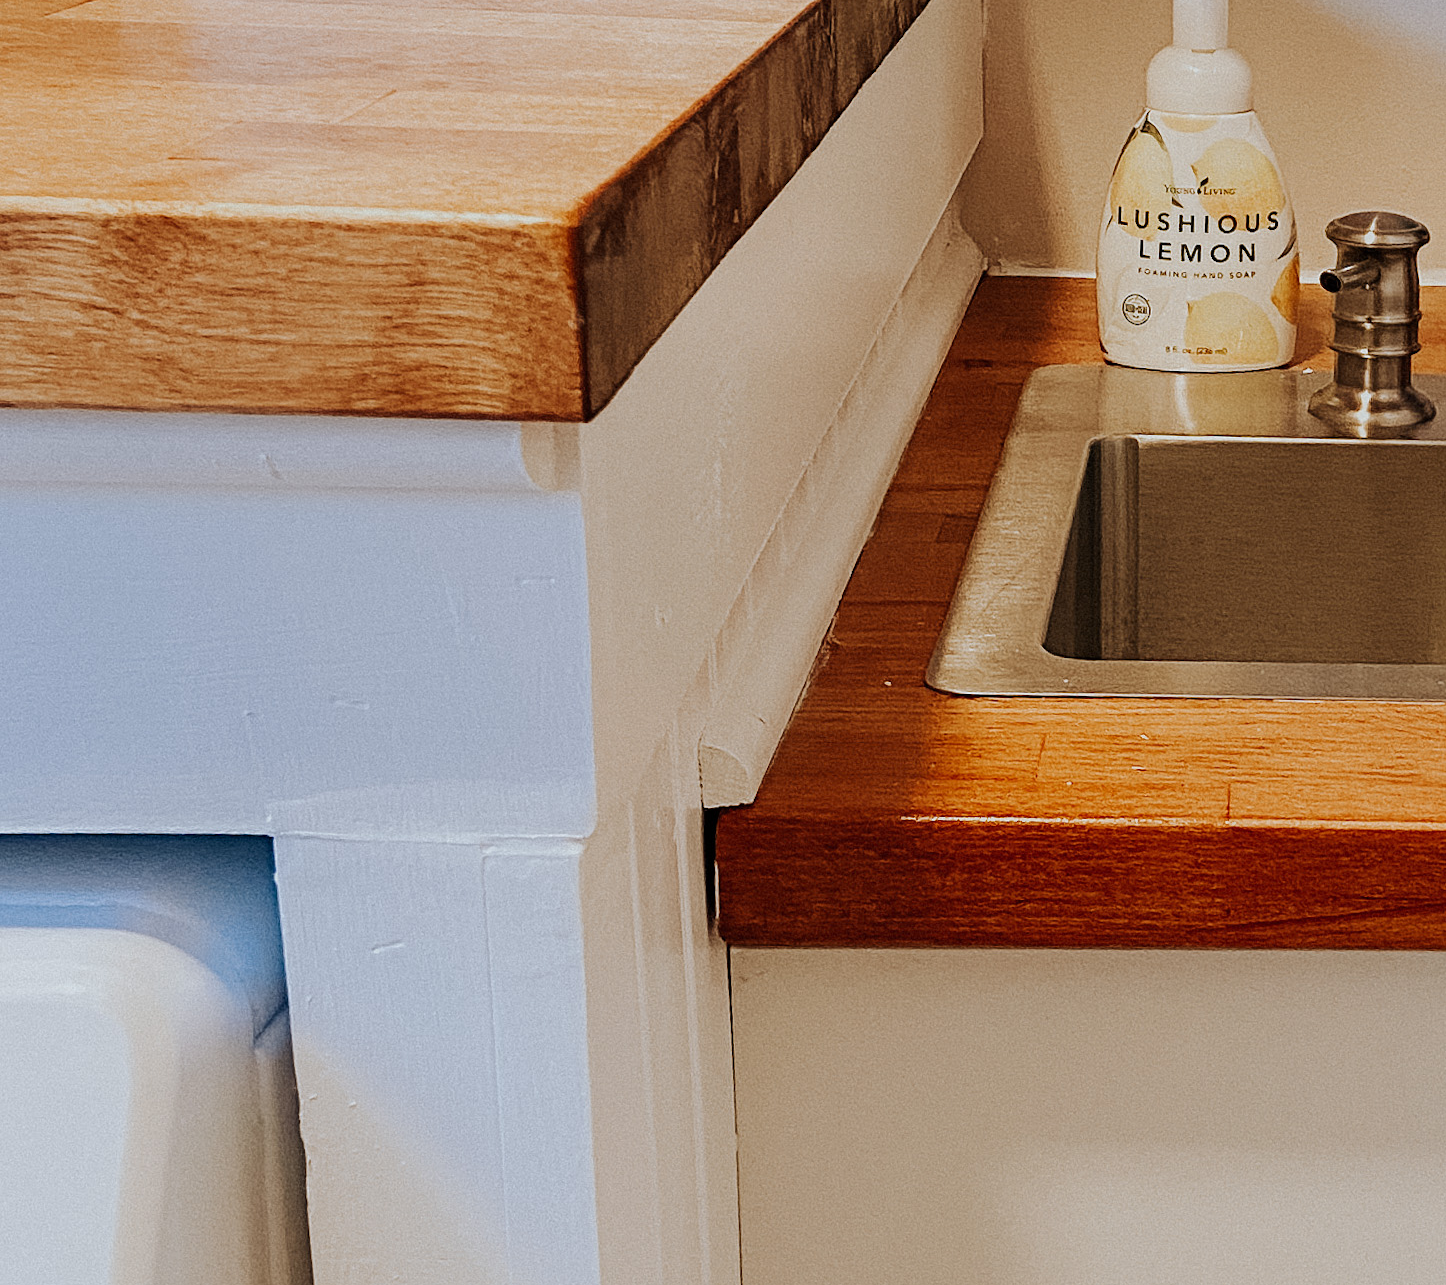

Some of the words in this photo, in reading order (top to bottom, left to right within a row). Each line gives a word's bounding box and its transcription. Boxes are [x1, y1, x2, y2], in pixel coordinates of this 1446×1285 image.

[1203, 186, 1237, 196] LIVING
[1117, 205, 1280, 234] LUSHIOUS
[1139, 239, 1256, 263] LEMON
[1137, 267, 1188, 279] FOAMING
[1193, 271, 1224, 280] HAND
[1229, 270, 1257, 280] SOAP
